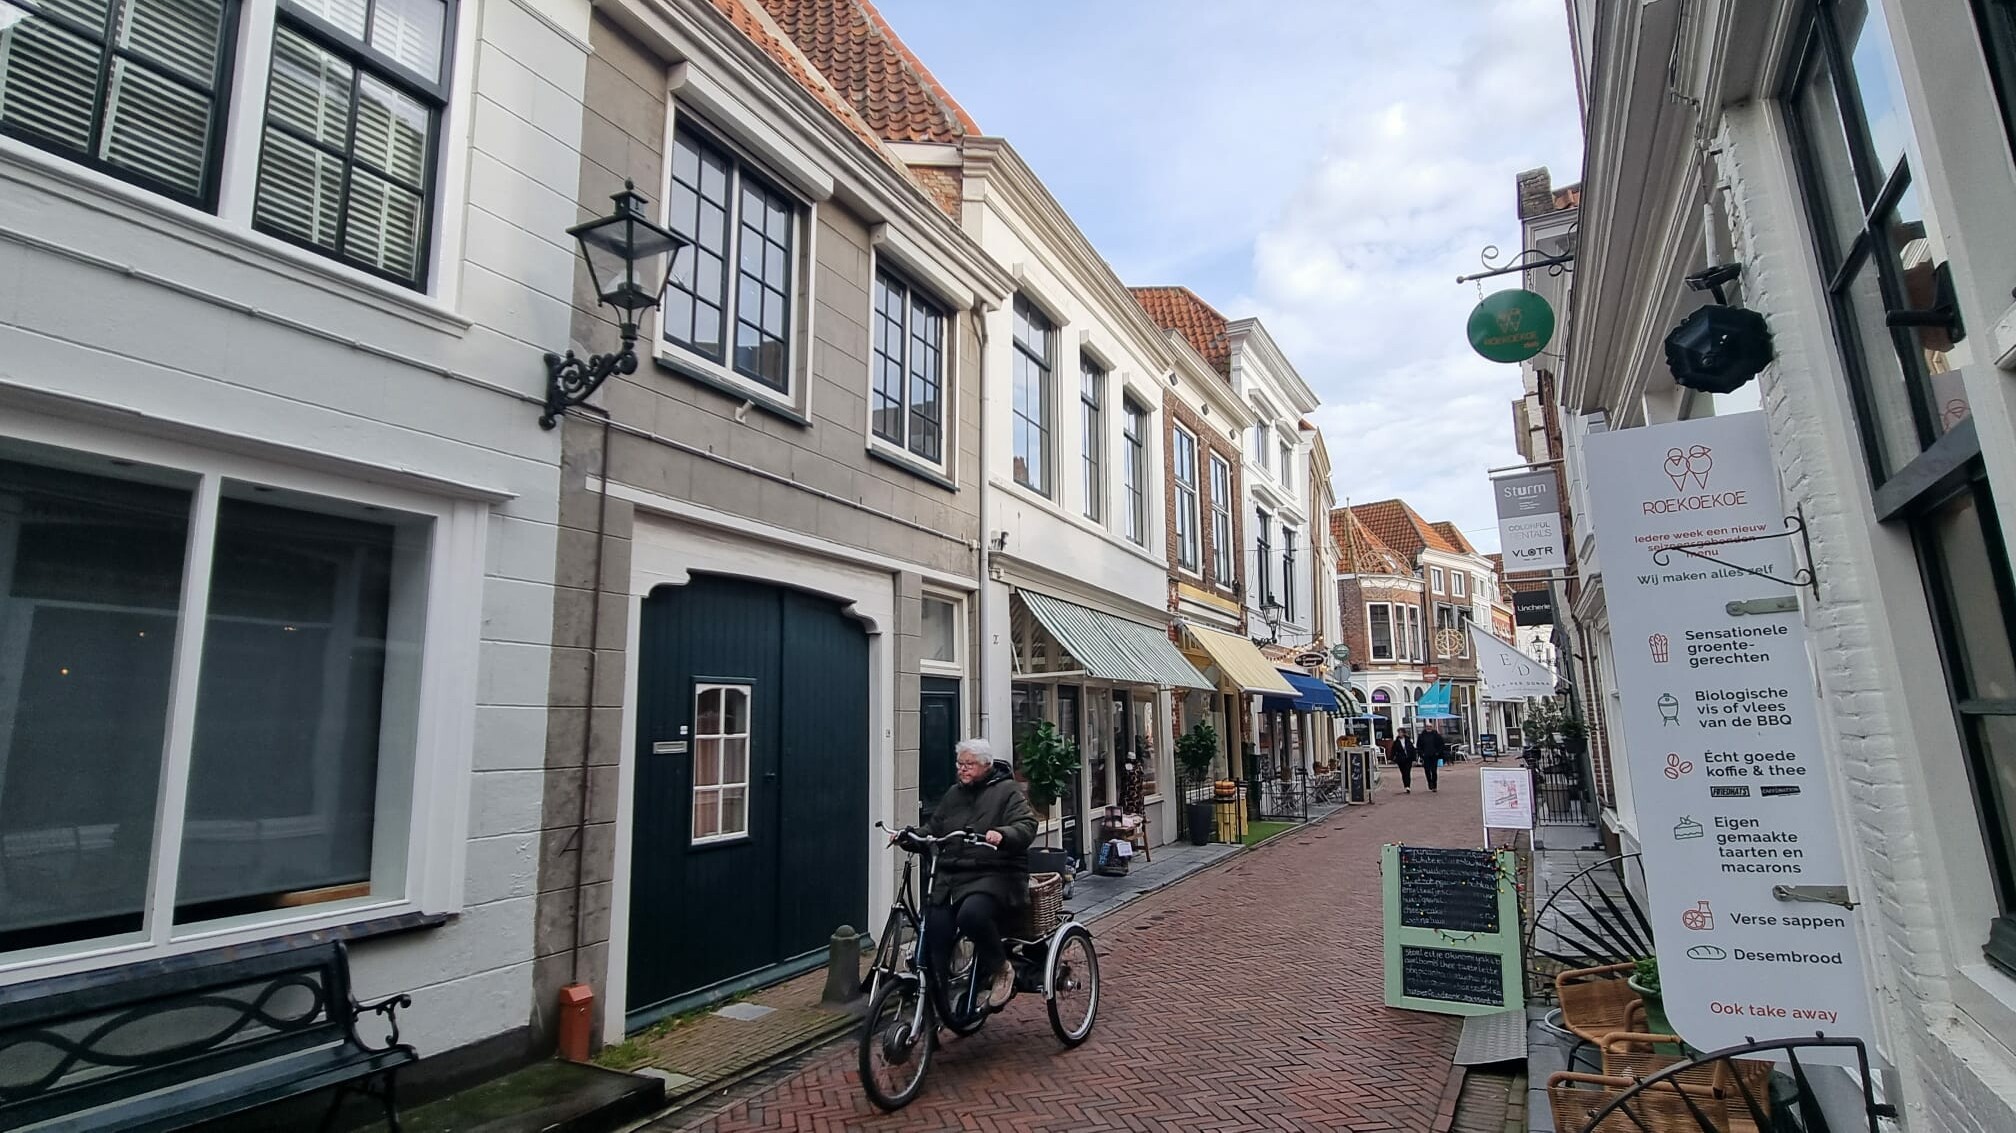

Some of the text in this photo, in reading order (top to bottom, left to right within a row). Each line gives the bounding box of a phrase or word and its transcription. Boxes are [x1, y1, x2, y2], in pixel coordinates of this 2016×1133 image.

[1642, 490, 1747, 515] ROEKOEKOE
[1634, 524, 1767, 543] Iedere week een nieuw
[1637, 574, 1659, 585] Wij
[1663, 572, 1707, 582] maken
[1711, 568, 1744, 579] alles
[1685, 624, 1788, 640] Sensationele
[1687, 640, 1755, 656] groente-
[1689, 652, 1770, 669] gerechten
[1695, 687, 1788, 702] Biologische
[1697, 701, 1786, 714] vis of vlees
[1699, 714, 1792, 728] van de BBQ
[1743, 750, 1796, 765] goede
[1706, 764, 1807, 777] koffie & thee
[1714, 816, 1760, 831] Eigen
[1716, 831, 1798, 846] gemaakte
[1719, 846, 1804, 858] taarten en
[1721, 863, 1802, 874] macarons
[1730, 913, 1846, 930] Verse sappen
[1734, 948, 1843, 965] Desembrood
[1710, 1002, 1838, 1024] Ook take away
